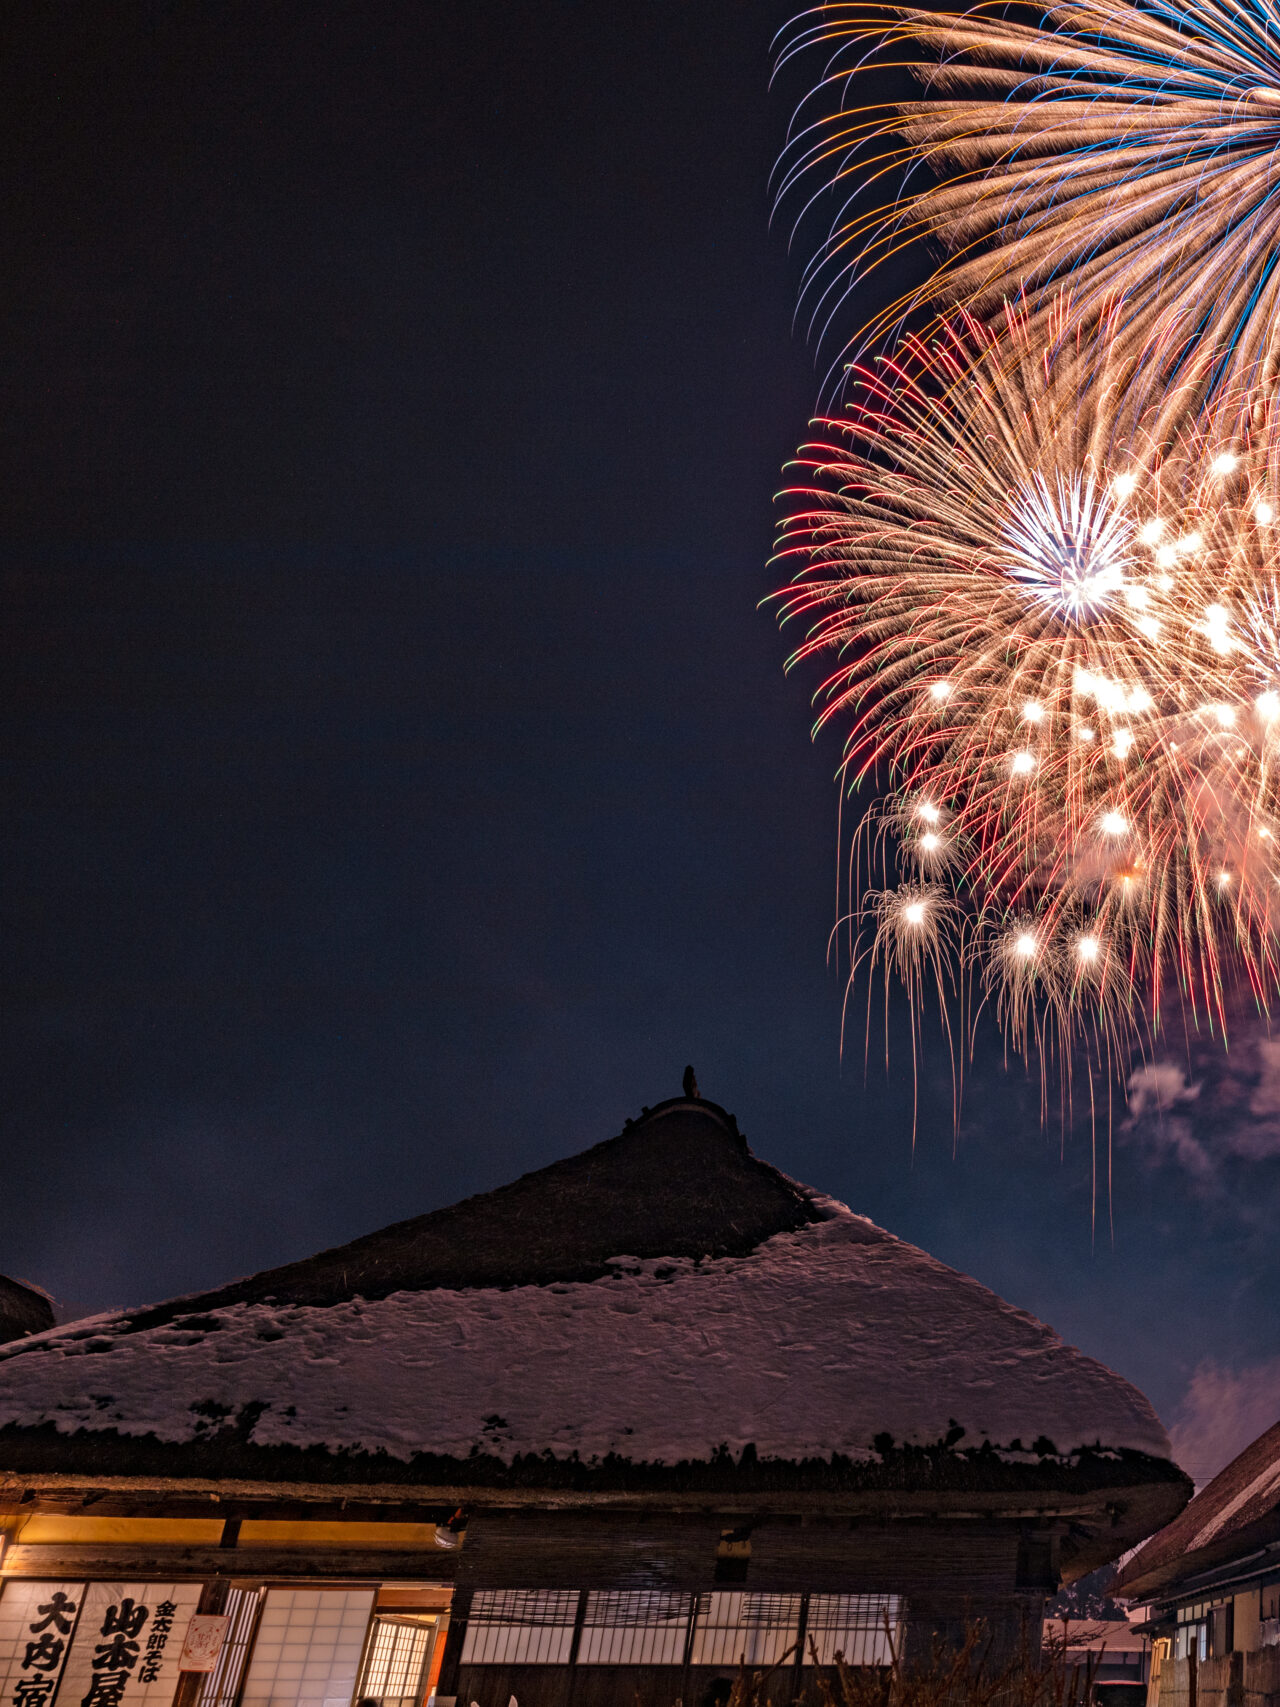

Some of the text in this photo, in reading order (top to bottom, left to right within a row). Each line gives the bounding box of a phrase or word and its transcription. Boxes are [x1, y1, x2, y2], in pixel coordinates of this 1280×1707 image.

[12, 1591, 77, 1707] 大内宿
[81, 1598, 149, 1707] 山本屋
[137, 1600, 177, 1683] 金太郎そば
